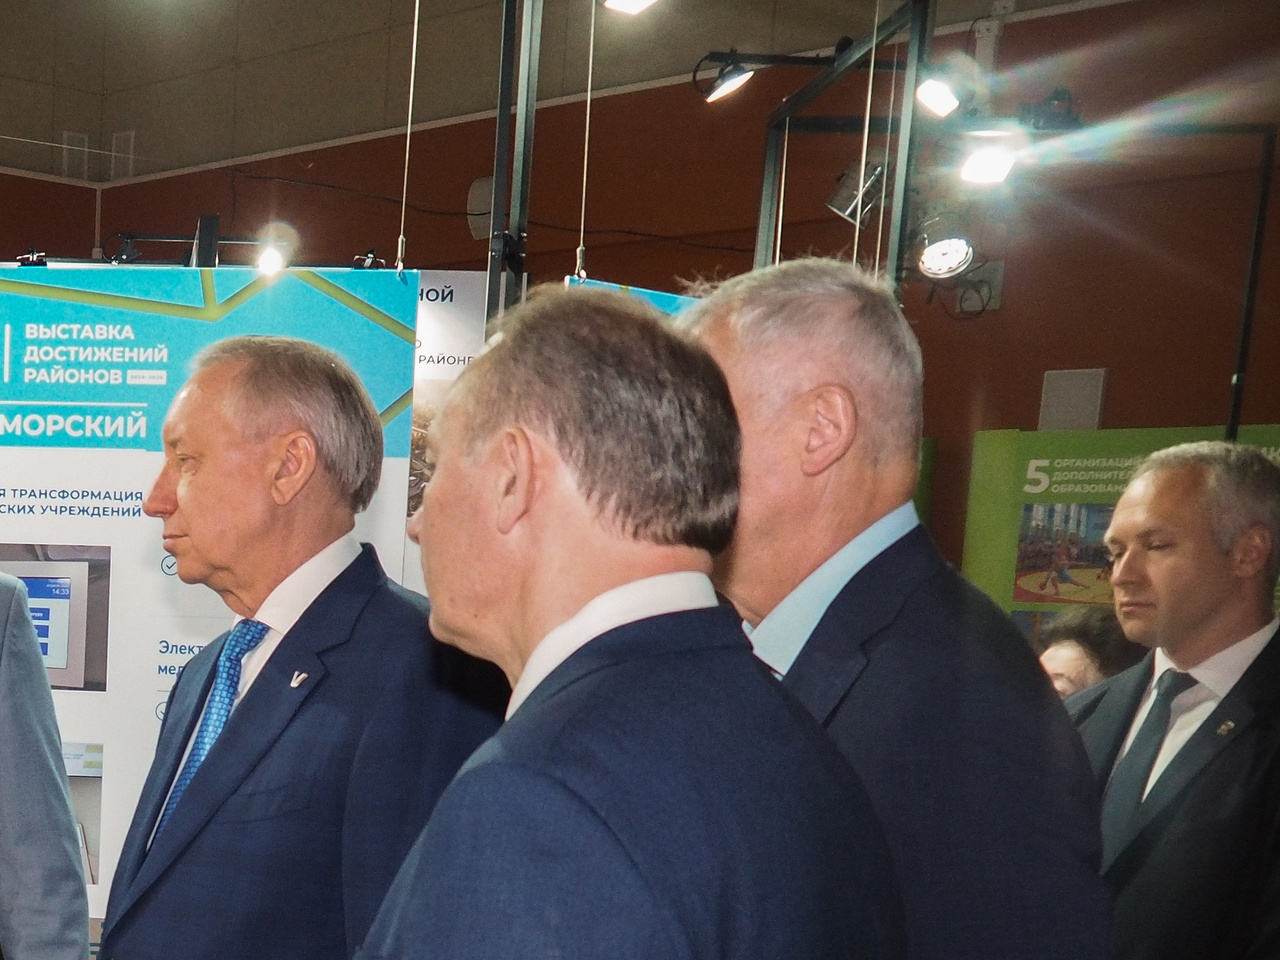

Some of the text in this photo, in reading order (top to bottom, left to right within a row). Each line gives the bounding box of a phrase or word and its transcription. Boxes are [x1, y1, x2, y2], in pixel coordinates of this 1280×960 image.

[24, 323, 135, 340] ВЫСТАВКА
[23, 344, 169, 363] ДОСТИЖЕНИЙ
[23, 366, 122, 384] РАЙОНОВ
[1023, 459, 1051, 493] 5
[1052, 471, 1133, 481] ДОПОЛНИТЕЛ
[11, 489, 143, 502] ТРАНСФОРМАЦИЯ
[1051, 484, 1124, 493] ОБРАЗОВАН
[40, 505, 142, 518] УЧРЕЖДЕНИЙ
[159, 640, 205, 655] Элект
